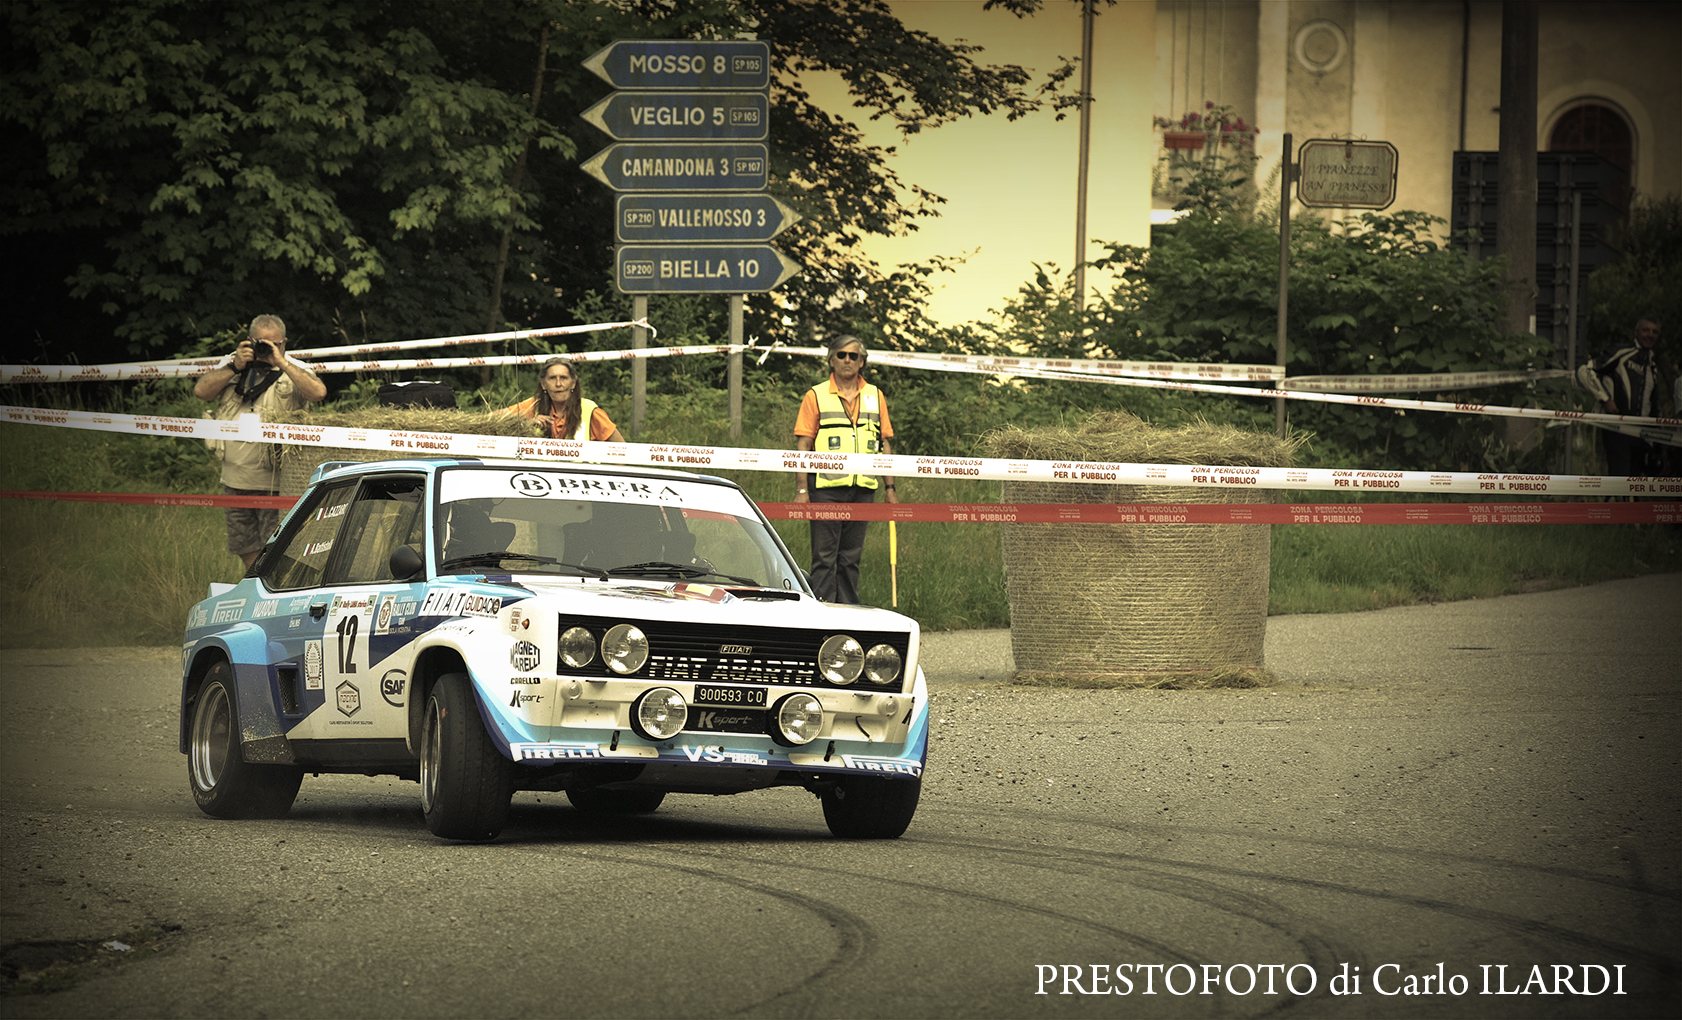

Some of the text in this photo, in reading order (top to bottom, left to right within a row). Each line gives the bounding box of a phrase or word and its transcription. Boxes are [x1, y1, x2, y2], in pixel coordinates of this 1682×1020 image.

[630, 55, 706, 74] MOSSO
[713, 55, 726, 74] 8
[630, 107, 705, 125] VEGLIO
[712, 107, 725, 125] 5
[622, 158, 715, 176] CAMANDONA
[720, 158, 730, 176] 3
[658, 209, 752, 227] VALLEMOSSO
[757, 209, 766, 227] 3
[660, 260, 730, 278] BIELLA
[738, 260, 760, 278] 10
[34, 415, 66, 424] PUBBLICO
[135, 422, 149, 430] PER
[161, 424, 193, 433] PUBBLICO
[263, 431, 276, 439] PER
[288, 433, 320, 442] PUBBLICO
[416, 441, 449, 450] PUBBLICO
[521, 447, 534, 455] PER
[546, 449, 579, 457] PUBBLICO
[651, 454, 665, 462] PER
[677, 456, 711, 464] PUBBLICO
[810, 462, 844, 470] PUBBLICO
[918, 466, 932, 474] PER
[944, 467, 979, 475] PUBBLICO
[1081, 472, 1116, 480] PUBBLICO
[1220, 476, 1256, 485] PUBBLICO
[558, 478, 680, 496] BRERA
[1363, 480, 1400, 488] PUBBLICO
[1480, 482, 1495, 490] PER
[1509, 483, 1547, 491] PUBBLICO
[1630, 484, 1645, 492] PER
[1649, 484, 1656, 492] IL
[789, 511, 803, 519] PER
[815, 512, 850, 520] PUBBLICO
[953, 513, 1016, 522] PER IL PUBBLICO
[423, 592, 466, 612] FIAT
[211, 598, 246, 623] PIRELLI
[336, 614, 359, 674] 12
[649, 656, 815, 684] FIAT ABARTH
[700, 688, 742, 702] 900593
[510, 742, 600, 762] PIRELLI
[682, 745, 725, 762] VS
[841, 754, 922, 778] PIRELLI
